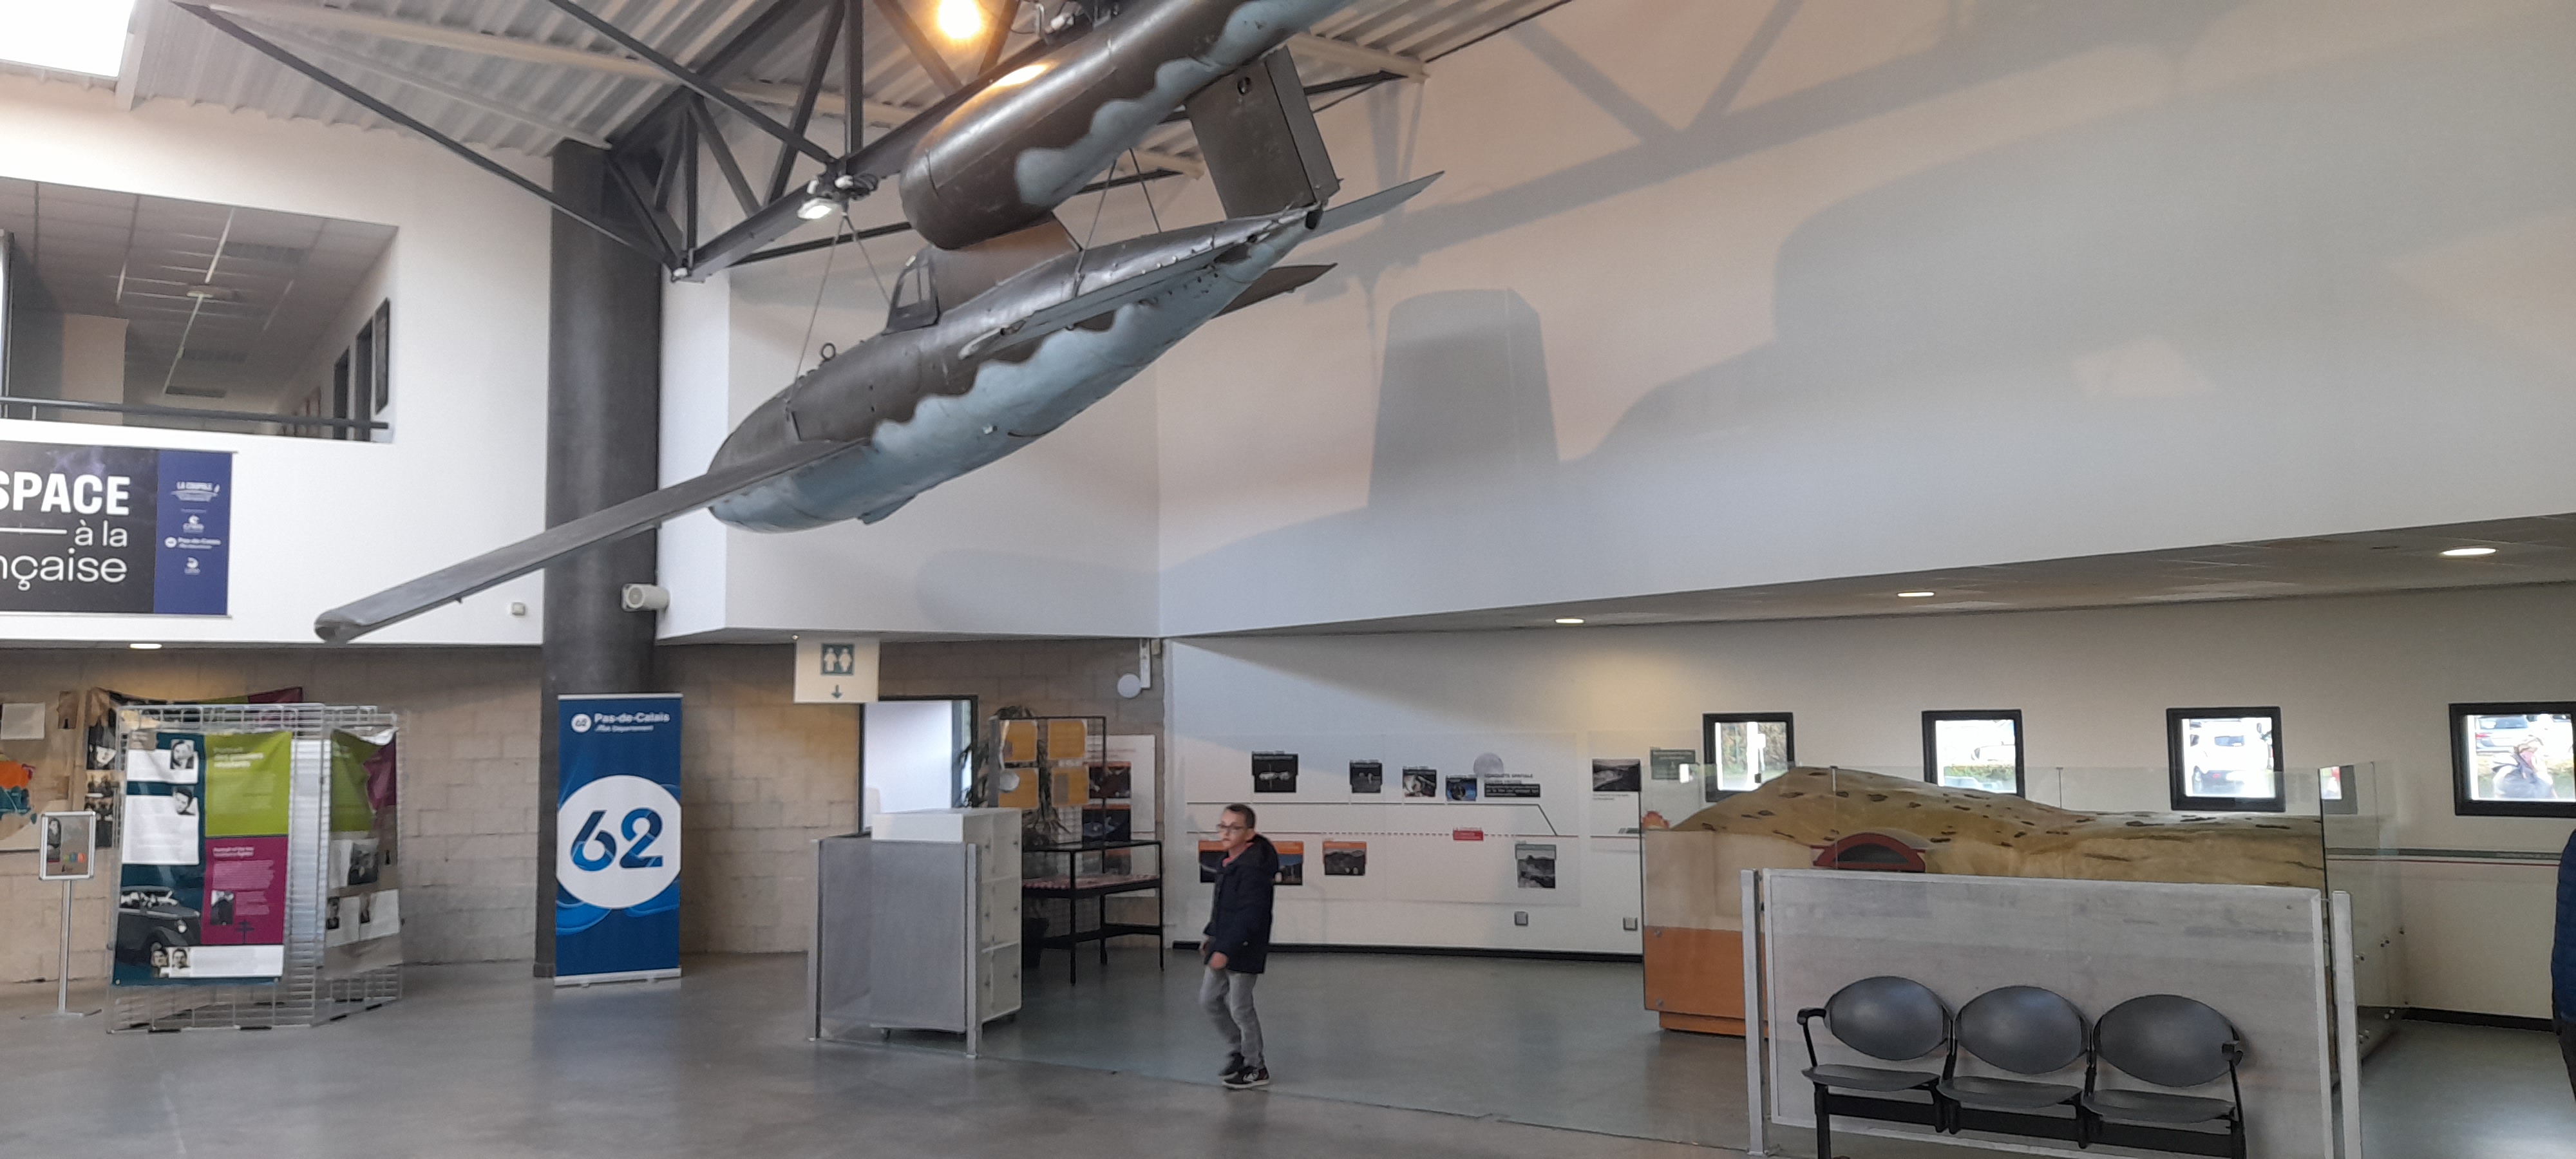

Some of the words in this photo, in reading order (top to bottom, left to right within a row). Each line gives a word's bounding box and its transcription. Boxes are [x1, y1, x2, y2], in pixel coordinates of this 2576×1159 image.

[74, 518, 93, 547] à
[102, 519, 128, 547] la
[570, 807, 664, 872] 62
